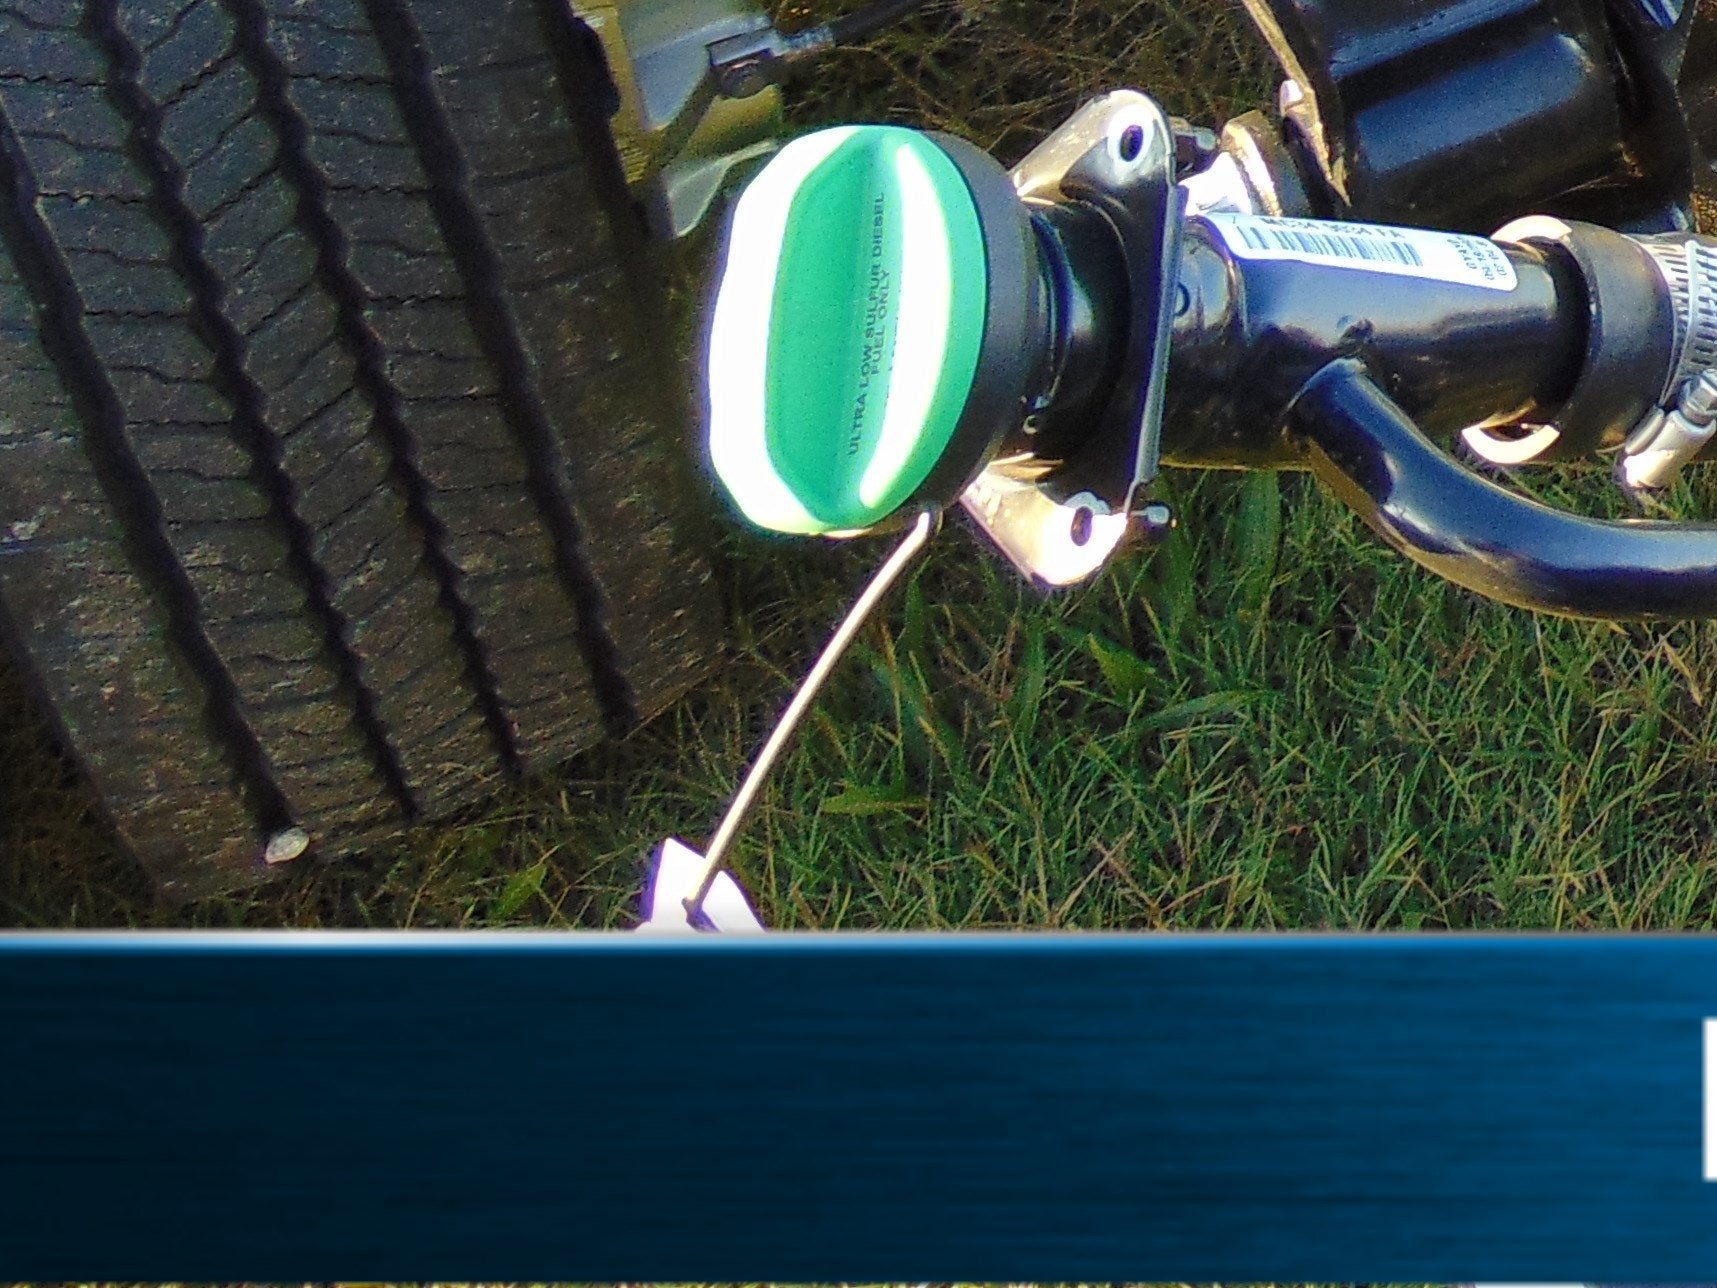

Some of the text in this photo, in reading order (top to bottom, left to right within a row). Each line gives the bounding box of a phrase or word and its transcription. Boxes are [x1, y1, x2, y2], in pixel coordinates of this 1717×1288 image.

[877, 269, 891, 322] ONLY
[848, 392, 869, 456] ULTRA
[859, 343, 873, 389] LOW
[871, 191, 885, 258] DIESEL
[870, 328, 885, 376] FUEL
